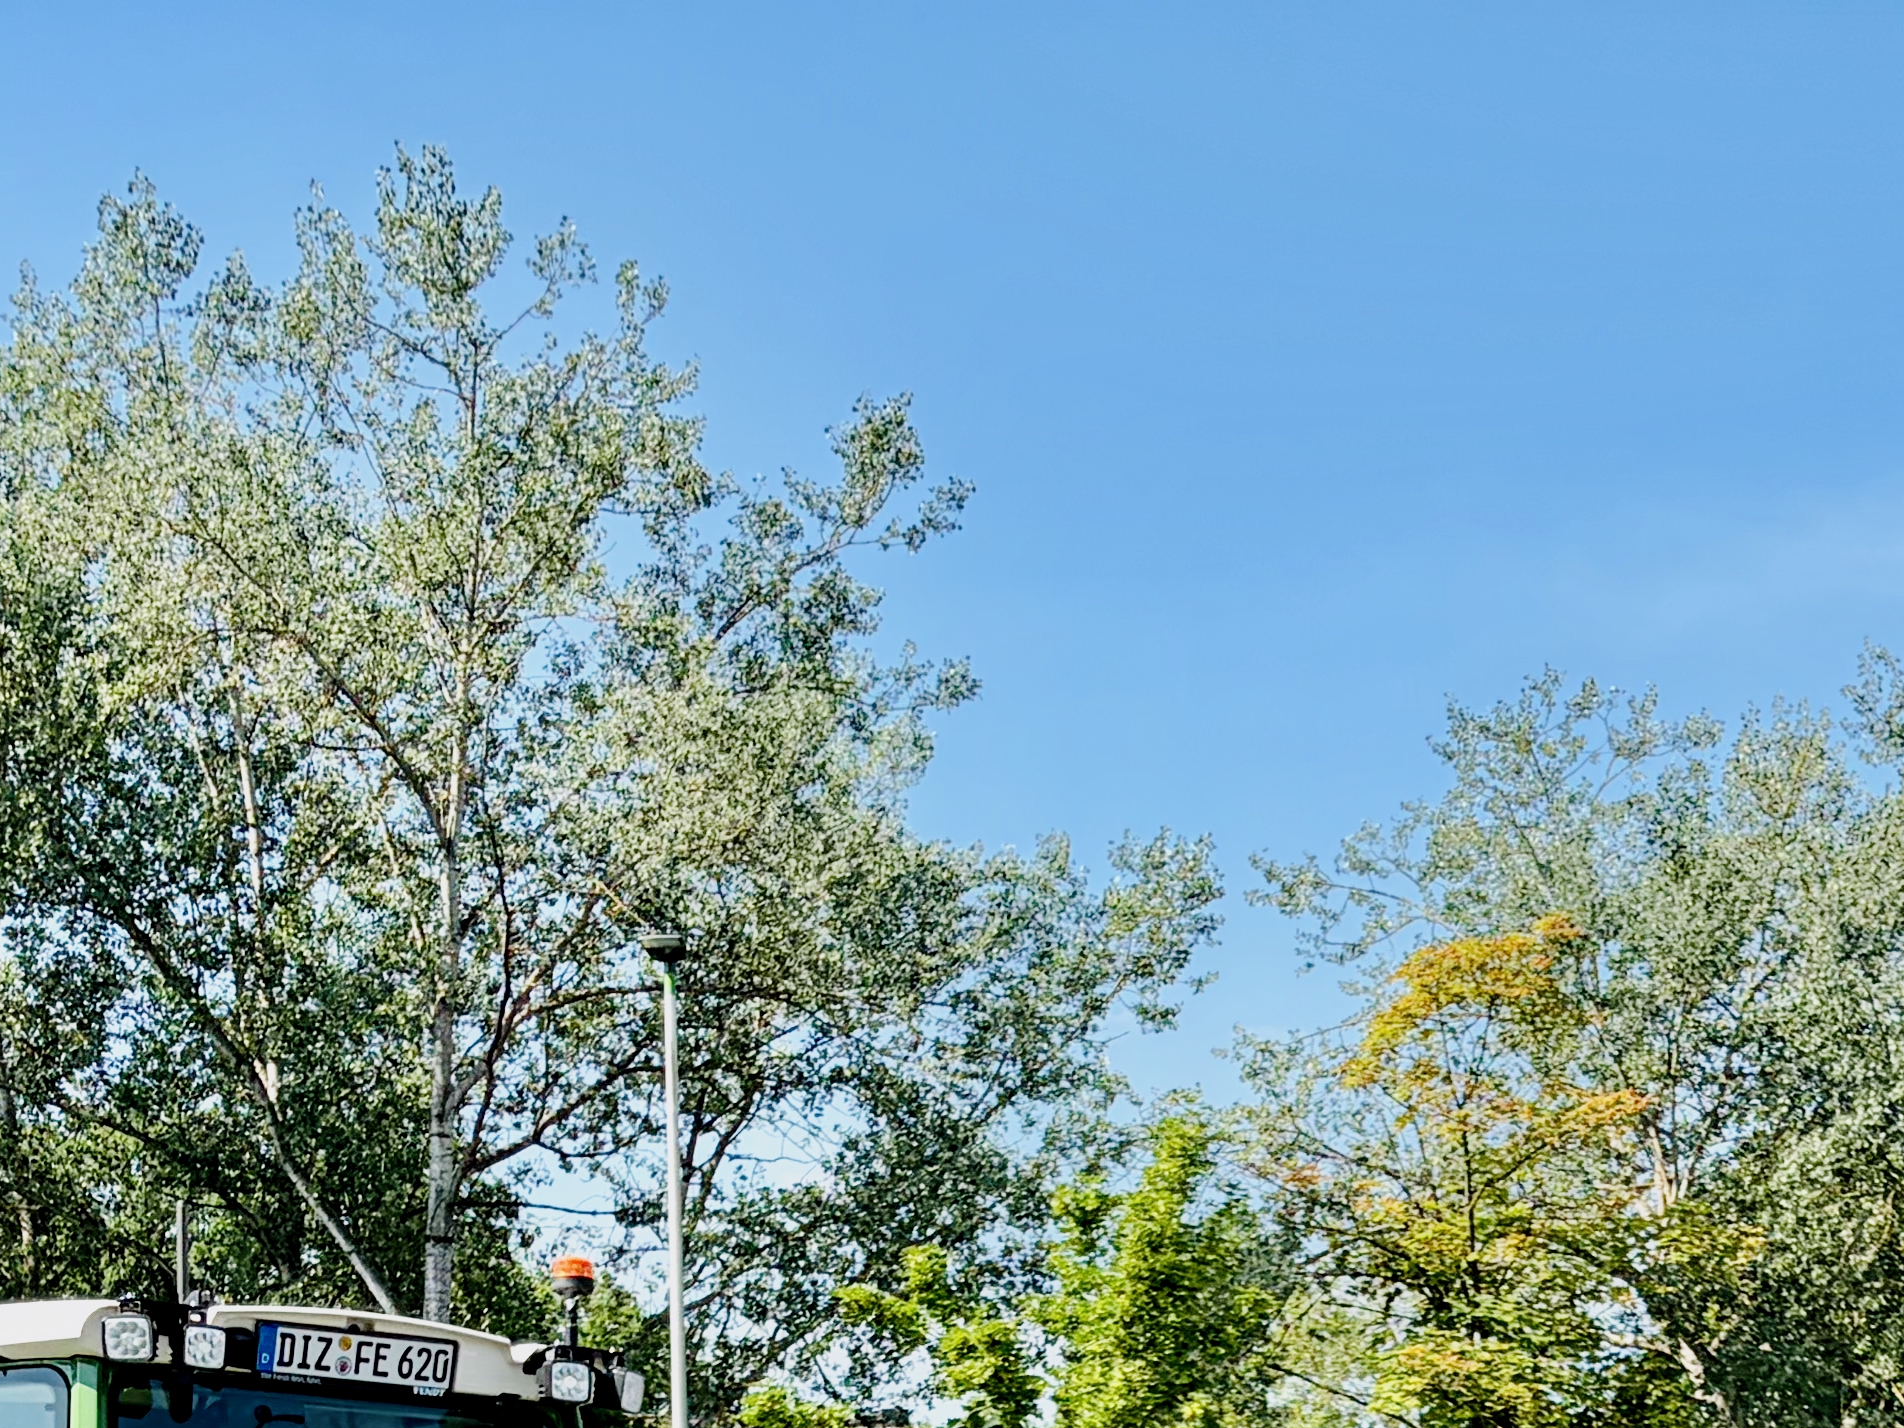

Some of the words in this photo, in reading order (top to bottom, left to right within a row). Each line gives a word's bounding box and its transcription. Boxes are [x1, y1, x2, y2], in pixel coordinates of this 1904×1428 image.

[277, 1332, 333, 1372] DIZ
[353, 1341, 391, 1378] FE
[398, 1345, 450, 1383] 620
